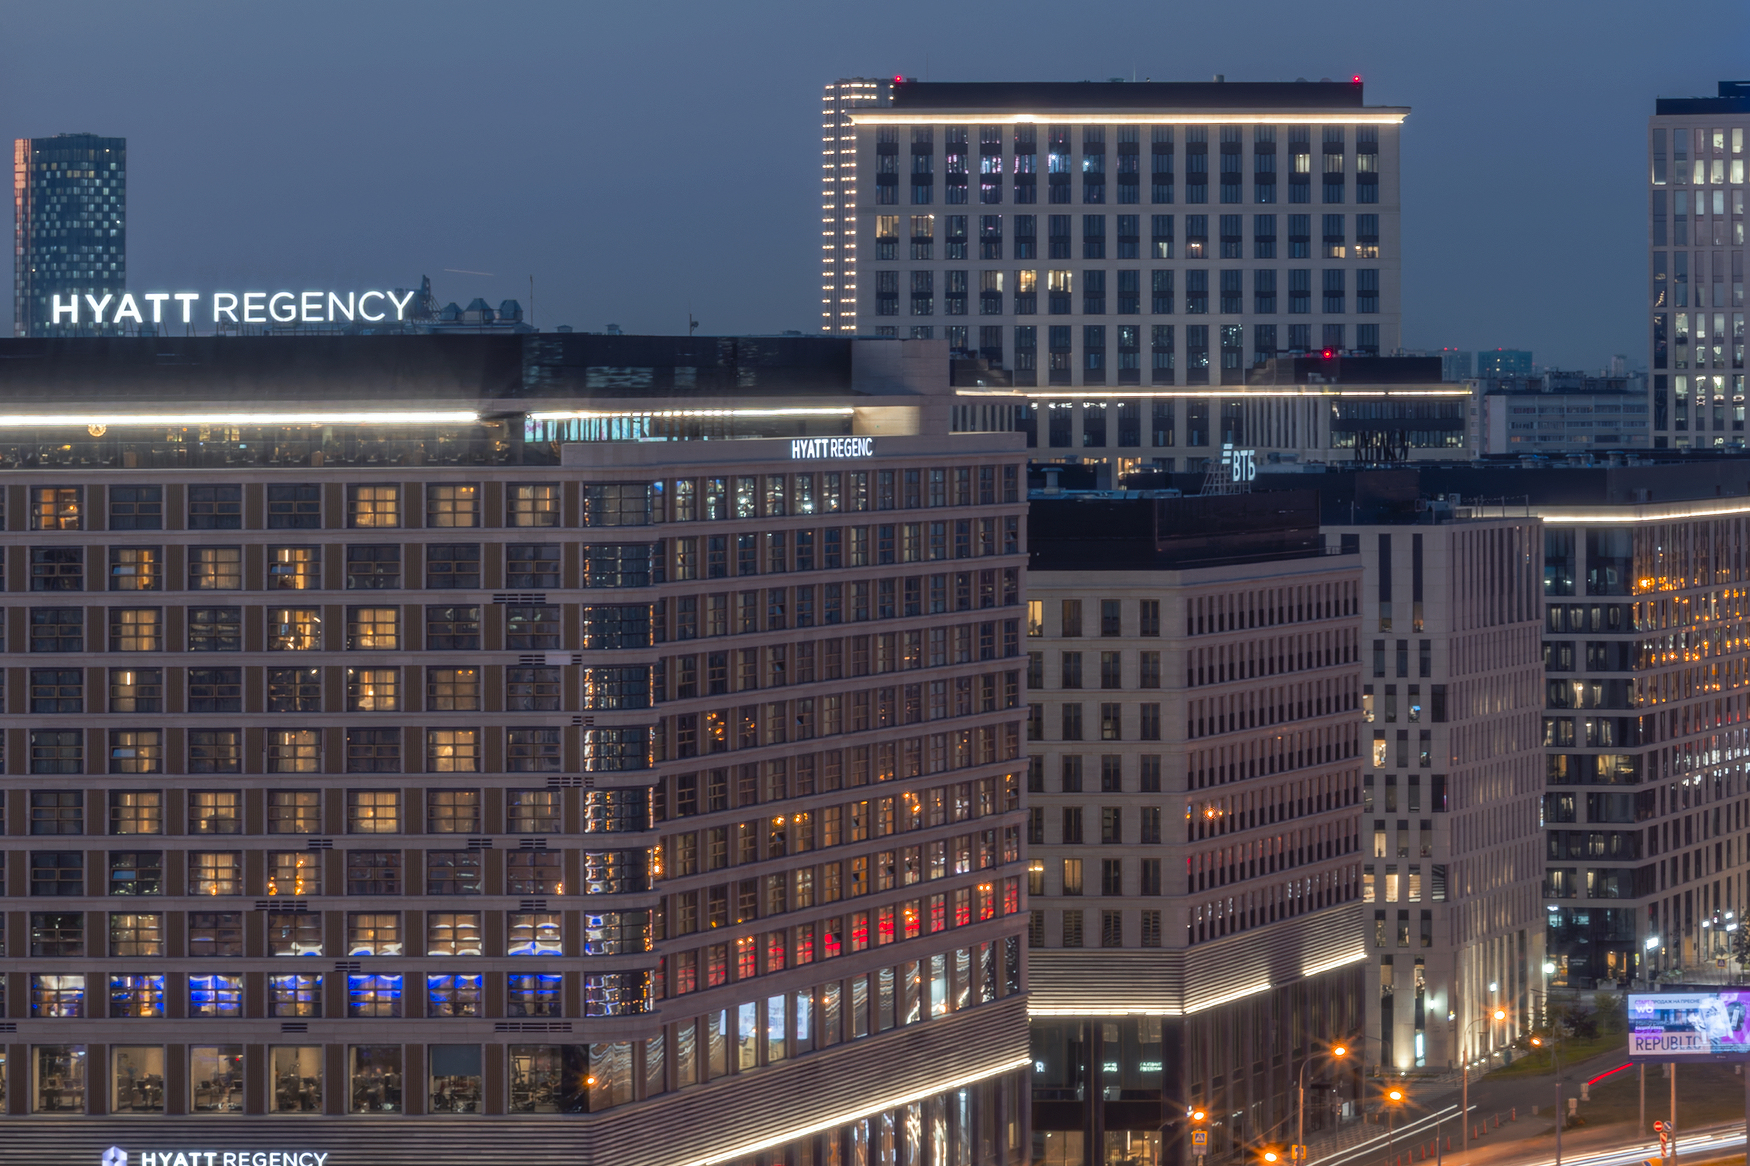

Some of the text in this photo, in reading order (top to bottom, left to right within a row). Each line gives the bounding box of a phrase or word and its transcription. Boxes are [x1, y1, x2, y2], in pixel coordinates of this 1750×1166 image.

[53, 291, 415, 324] HYATT REGENCY
[792, 439, 829, 459] HYATT
[1233, 449, 1256, 481] ВТБ
